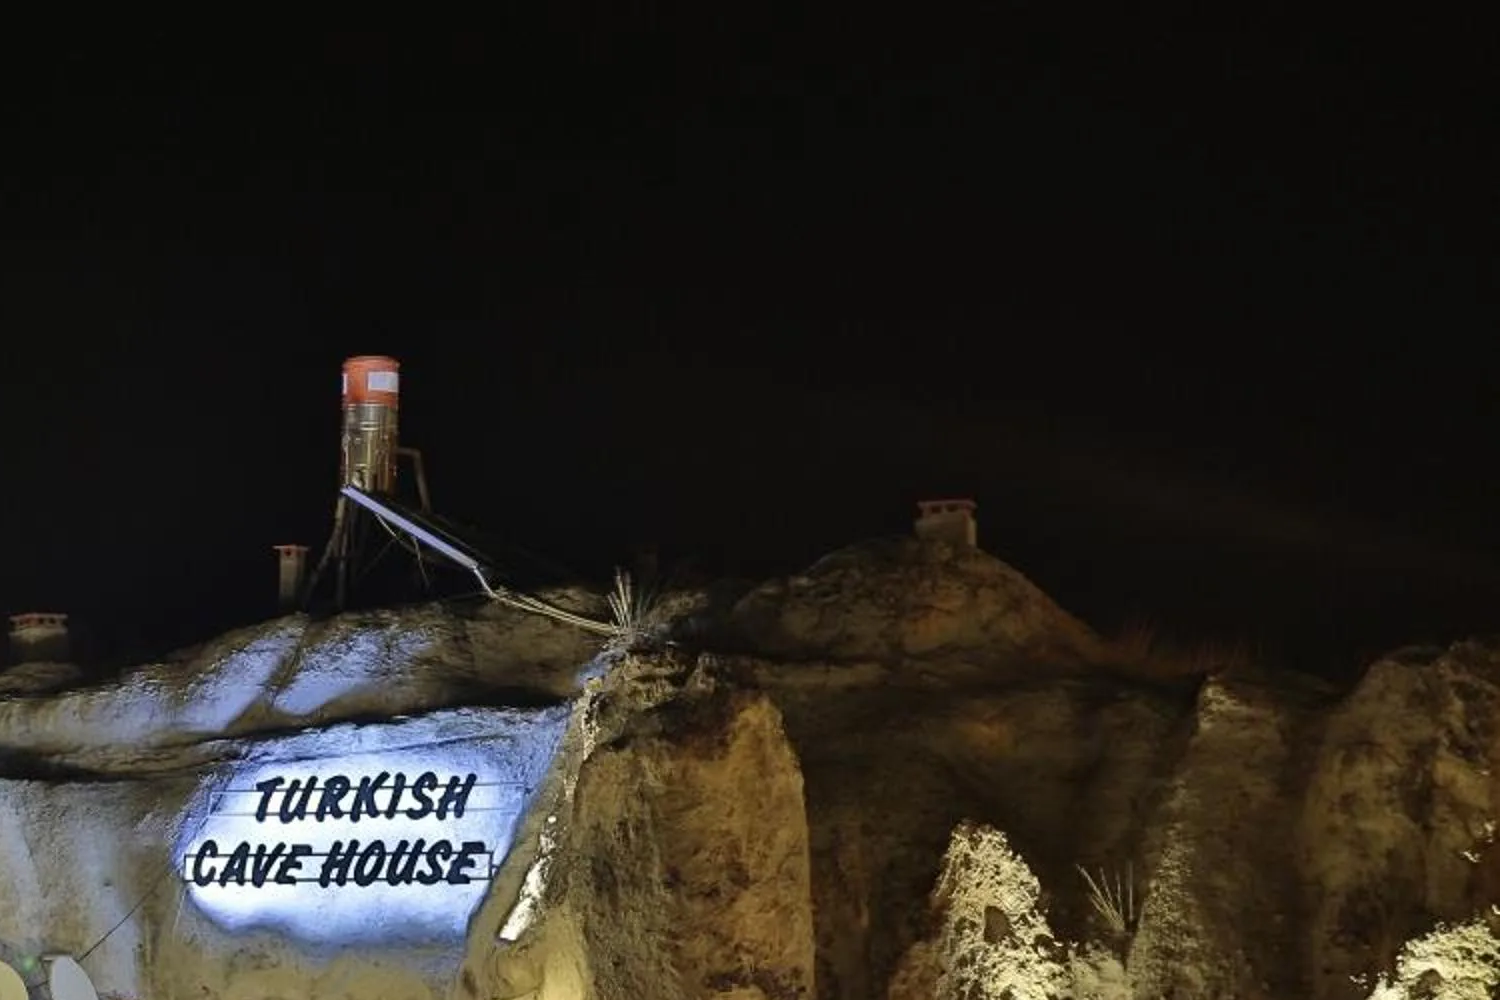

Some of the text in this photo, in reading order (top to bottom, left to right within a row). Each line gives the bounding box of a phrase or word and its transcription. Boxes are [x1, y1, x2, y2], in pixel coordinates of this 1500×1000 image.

[256, 772, 477, 823] TURKISH
[193, 839, 486, 887] CAVE HOUSE
